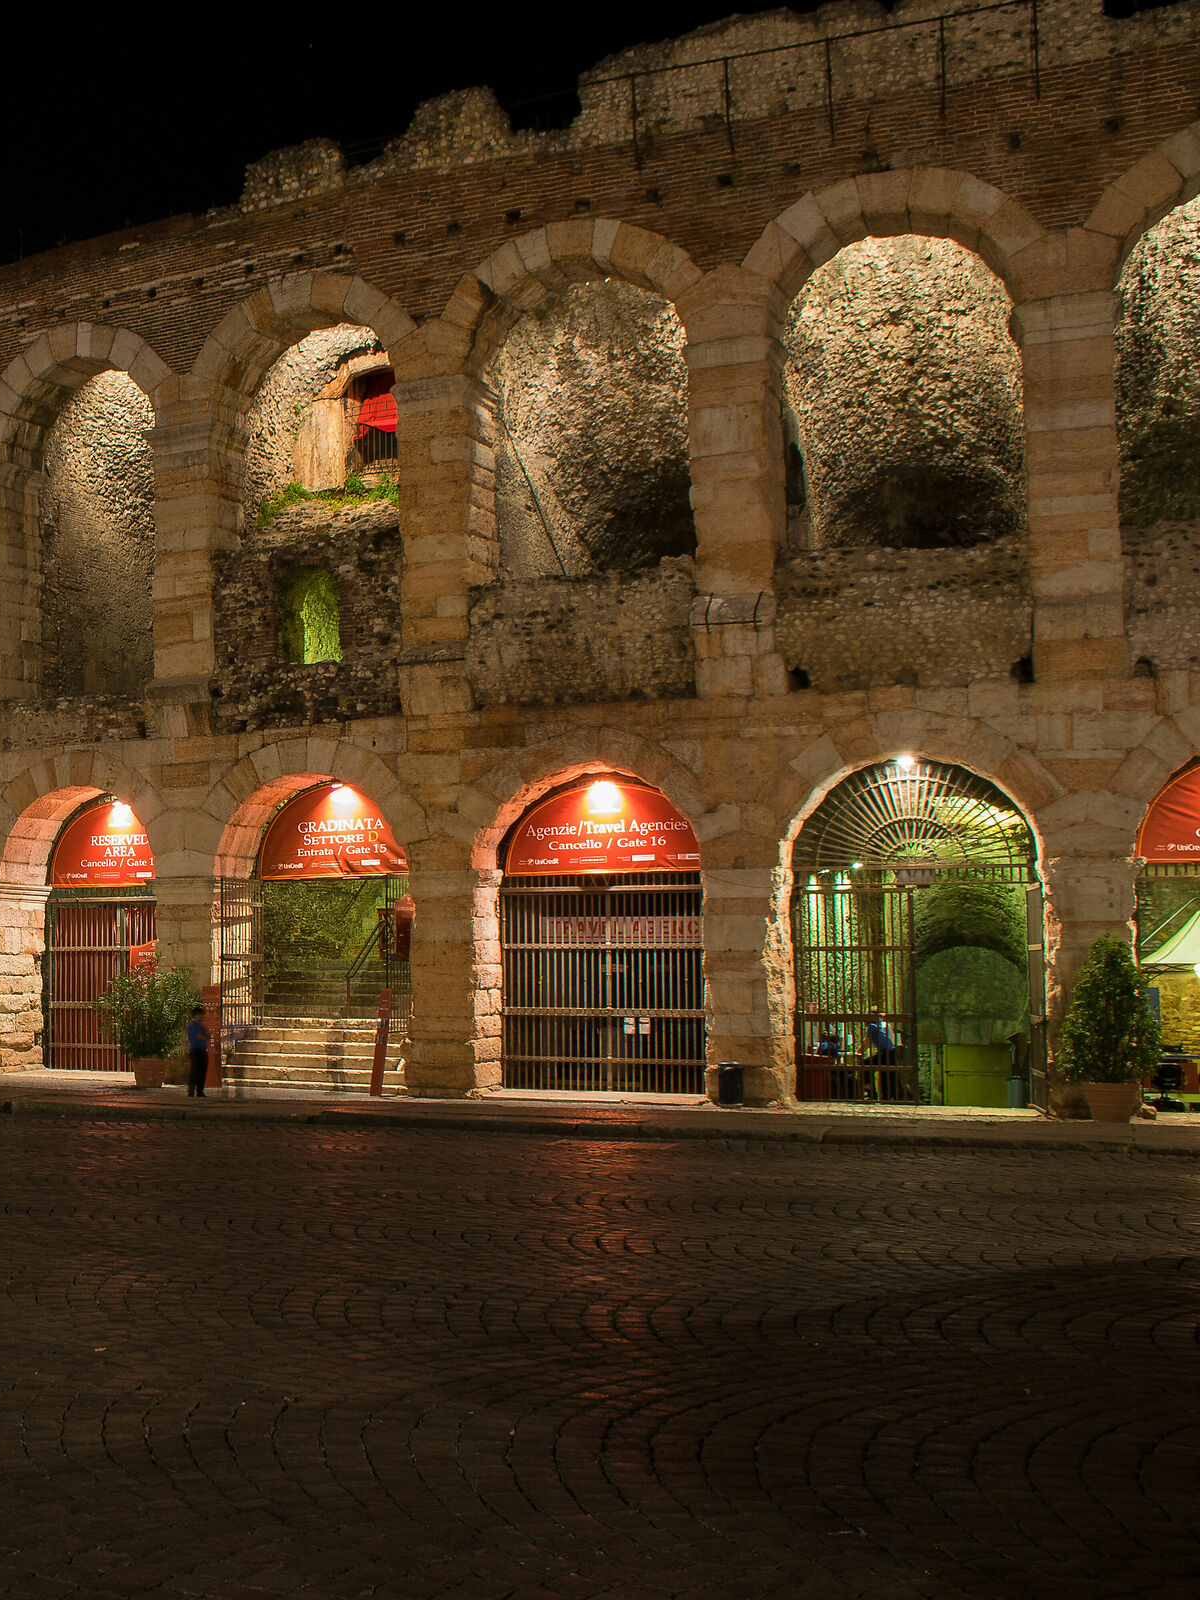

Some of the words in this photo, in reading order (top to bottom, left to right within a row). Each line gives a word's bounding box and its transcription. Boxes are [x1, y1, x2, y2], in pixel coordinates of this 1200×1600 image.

[297, 818, 385, 833] GRADINATA
[628, 818, 689, 835] Agencies
[303, 833, 365, 846] SETTORE
[368, 831, 379, 842] D
[548, 838, 602, 850] Cancello
[606, 838, 613, 849] /
[617, 837, 647, 848] Gate
[649, 835, 667, 846] 16
[104, 846, 136, 857] AREA
[297, 848, 334, 857] Entrata
[345, 845, 371, 854] Gate
[373, 844, 387, 853] 15
[80, 859, 117, 867] Cancello
[126, 858, 147, 866] Gate
